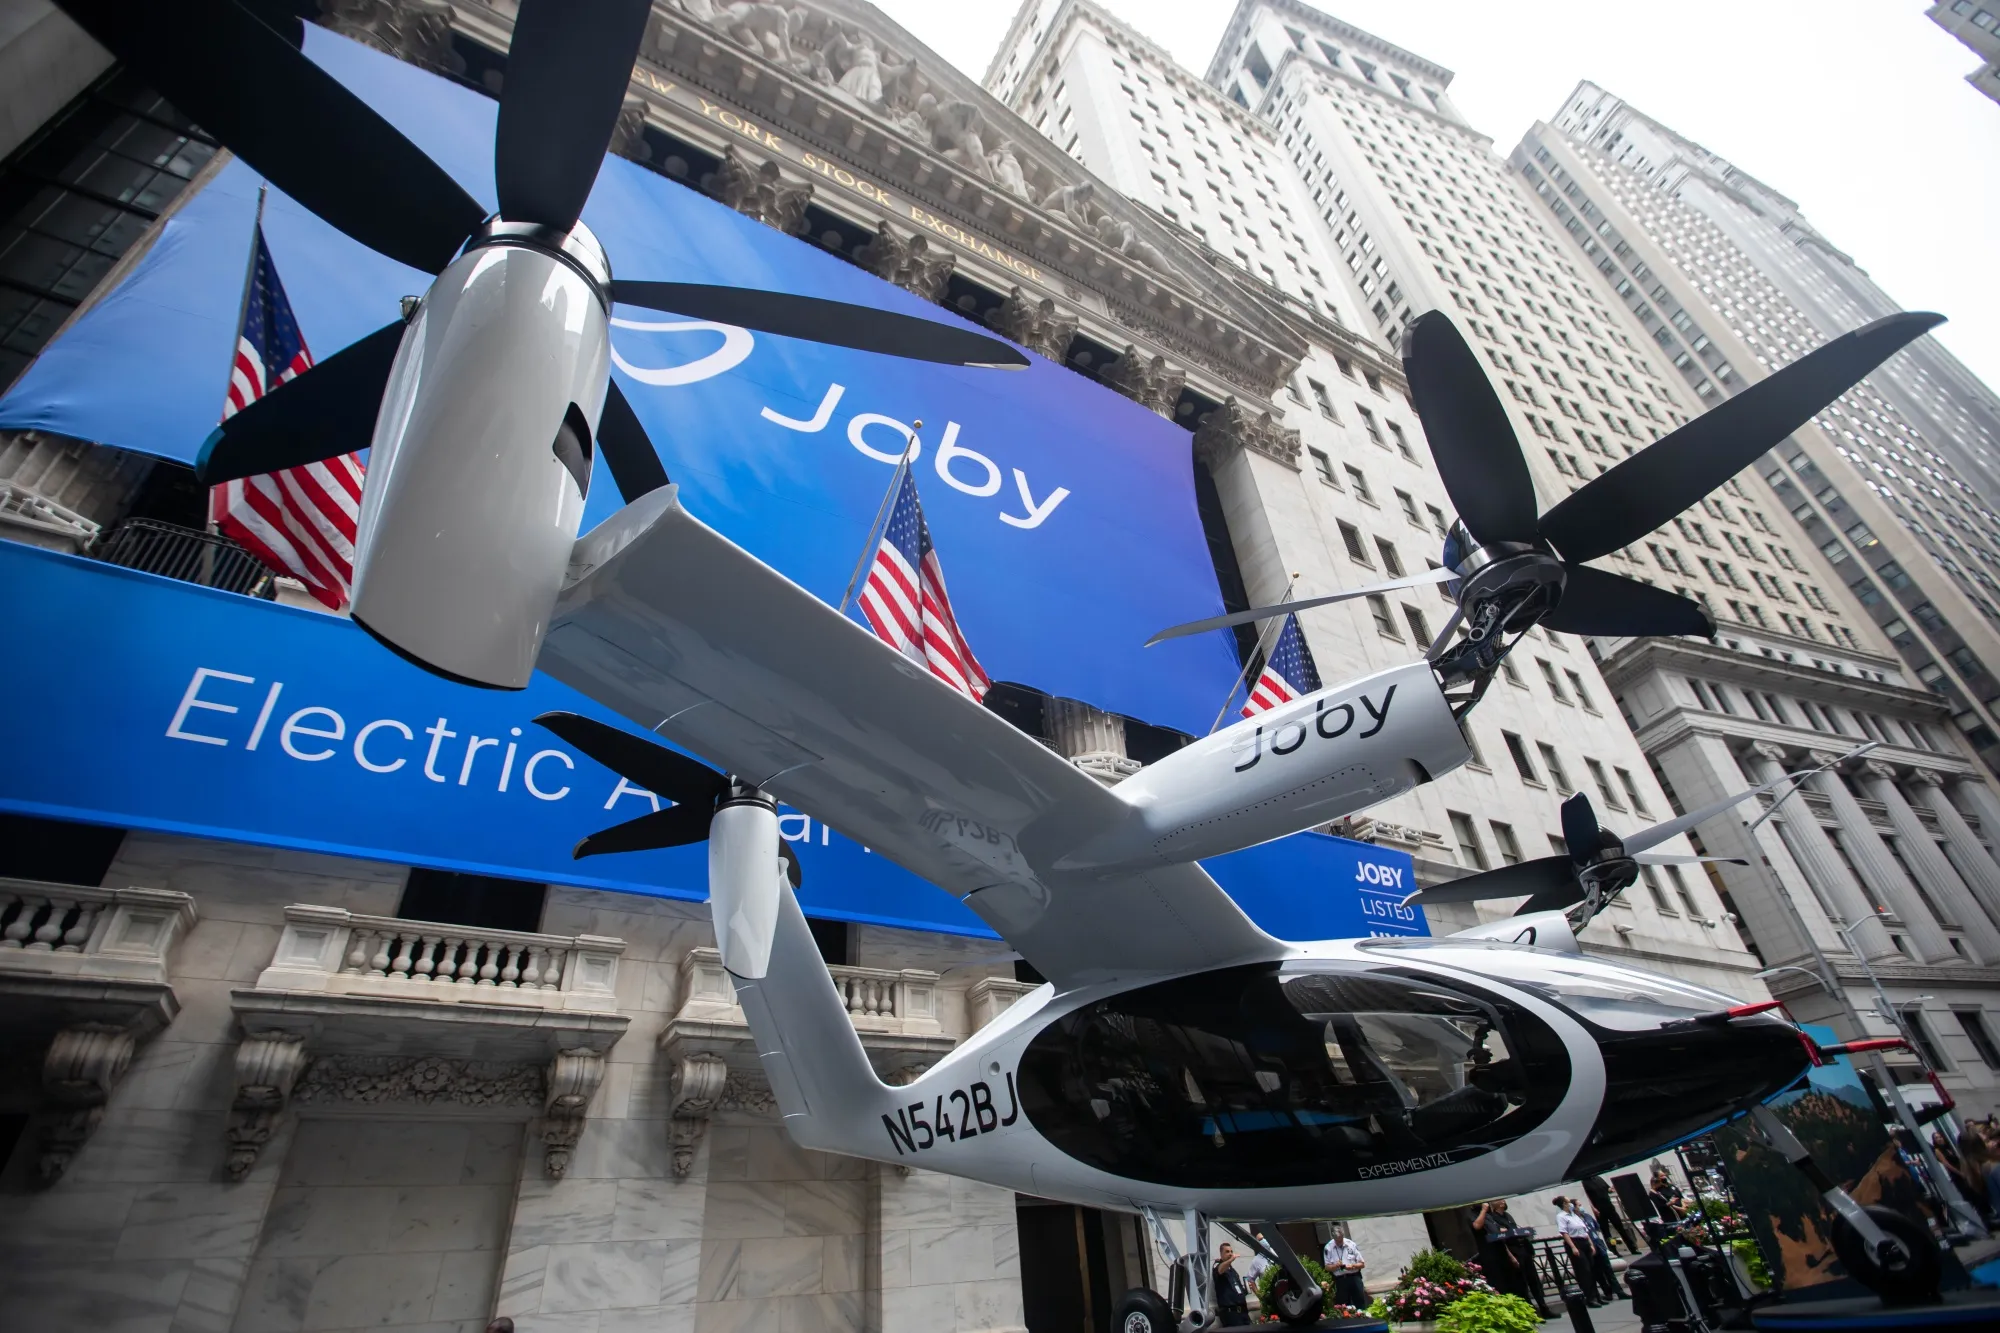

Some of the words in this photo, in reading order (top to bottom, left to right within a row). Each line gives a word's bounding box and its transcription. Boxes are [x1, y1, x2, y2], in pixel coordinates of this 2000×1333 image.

[632, 66, 676, 93] EW
[698, 98, 783, 152] YORK
[802, 153, 892, 208] STOCK
[910, 206, 1044, 284] EXCHANGE
[760, 383, 1070, 529] Joby
[165, 667, 575, 801] Electric
[1235, 684, 1397, 772] Joby
[1355, 861, 1402, 888] JOBY
[1361, 898, 1415, 921] LISTED
[881, 1072, 1018, 1155] N542BJ
[1358, 1152, 1455, 1179] EXPERIMENTAL
